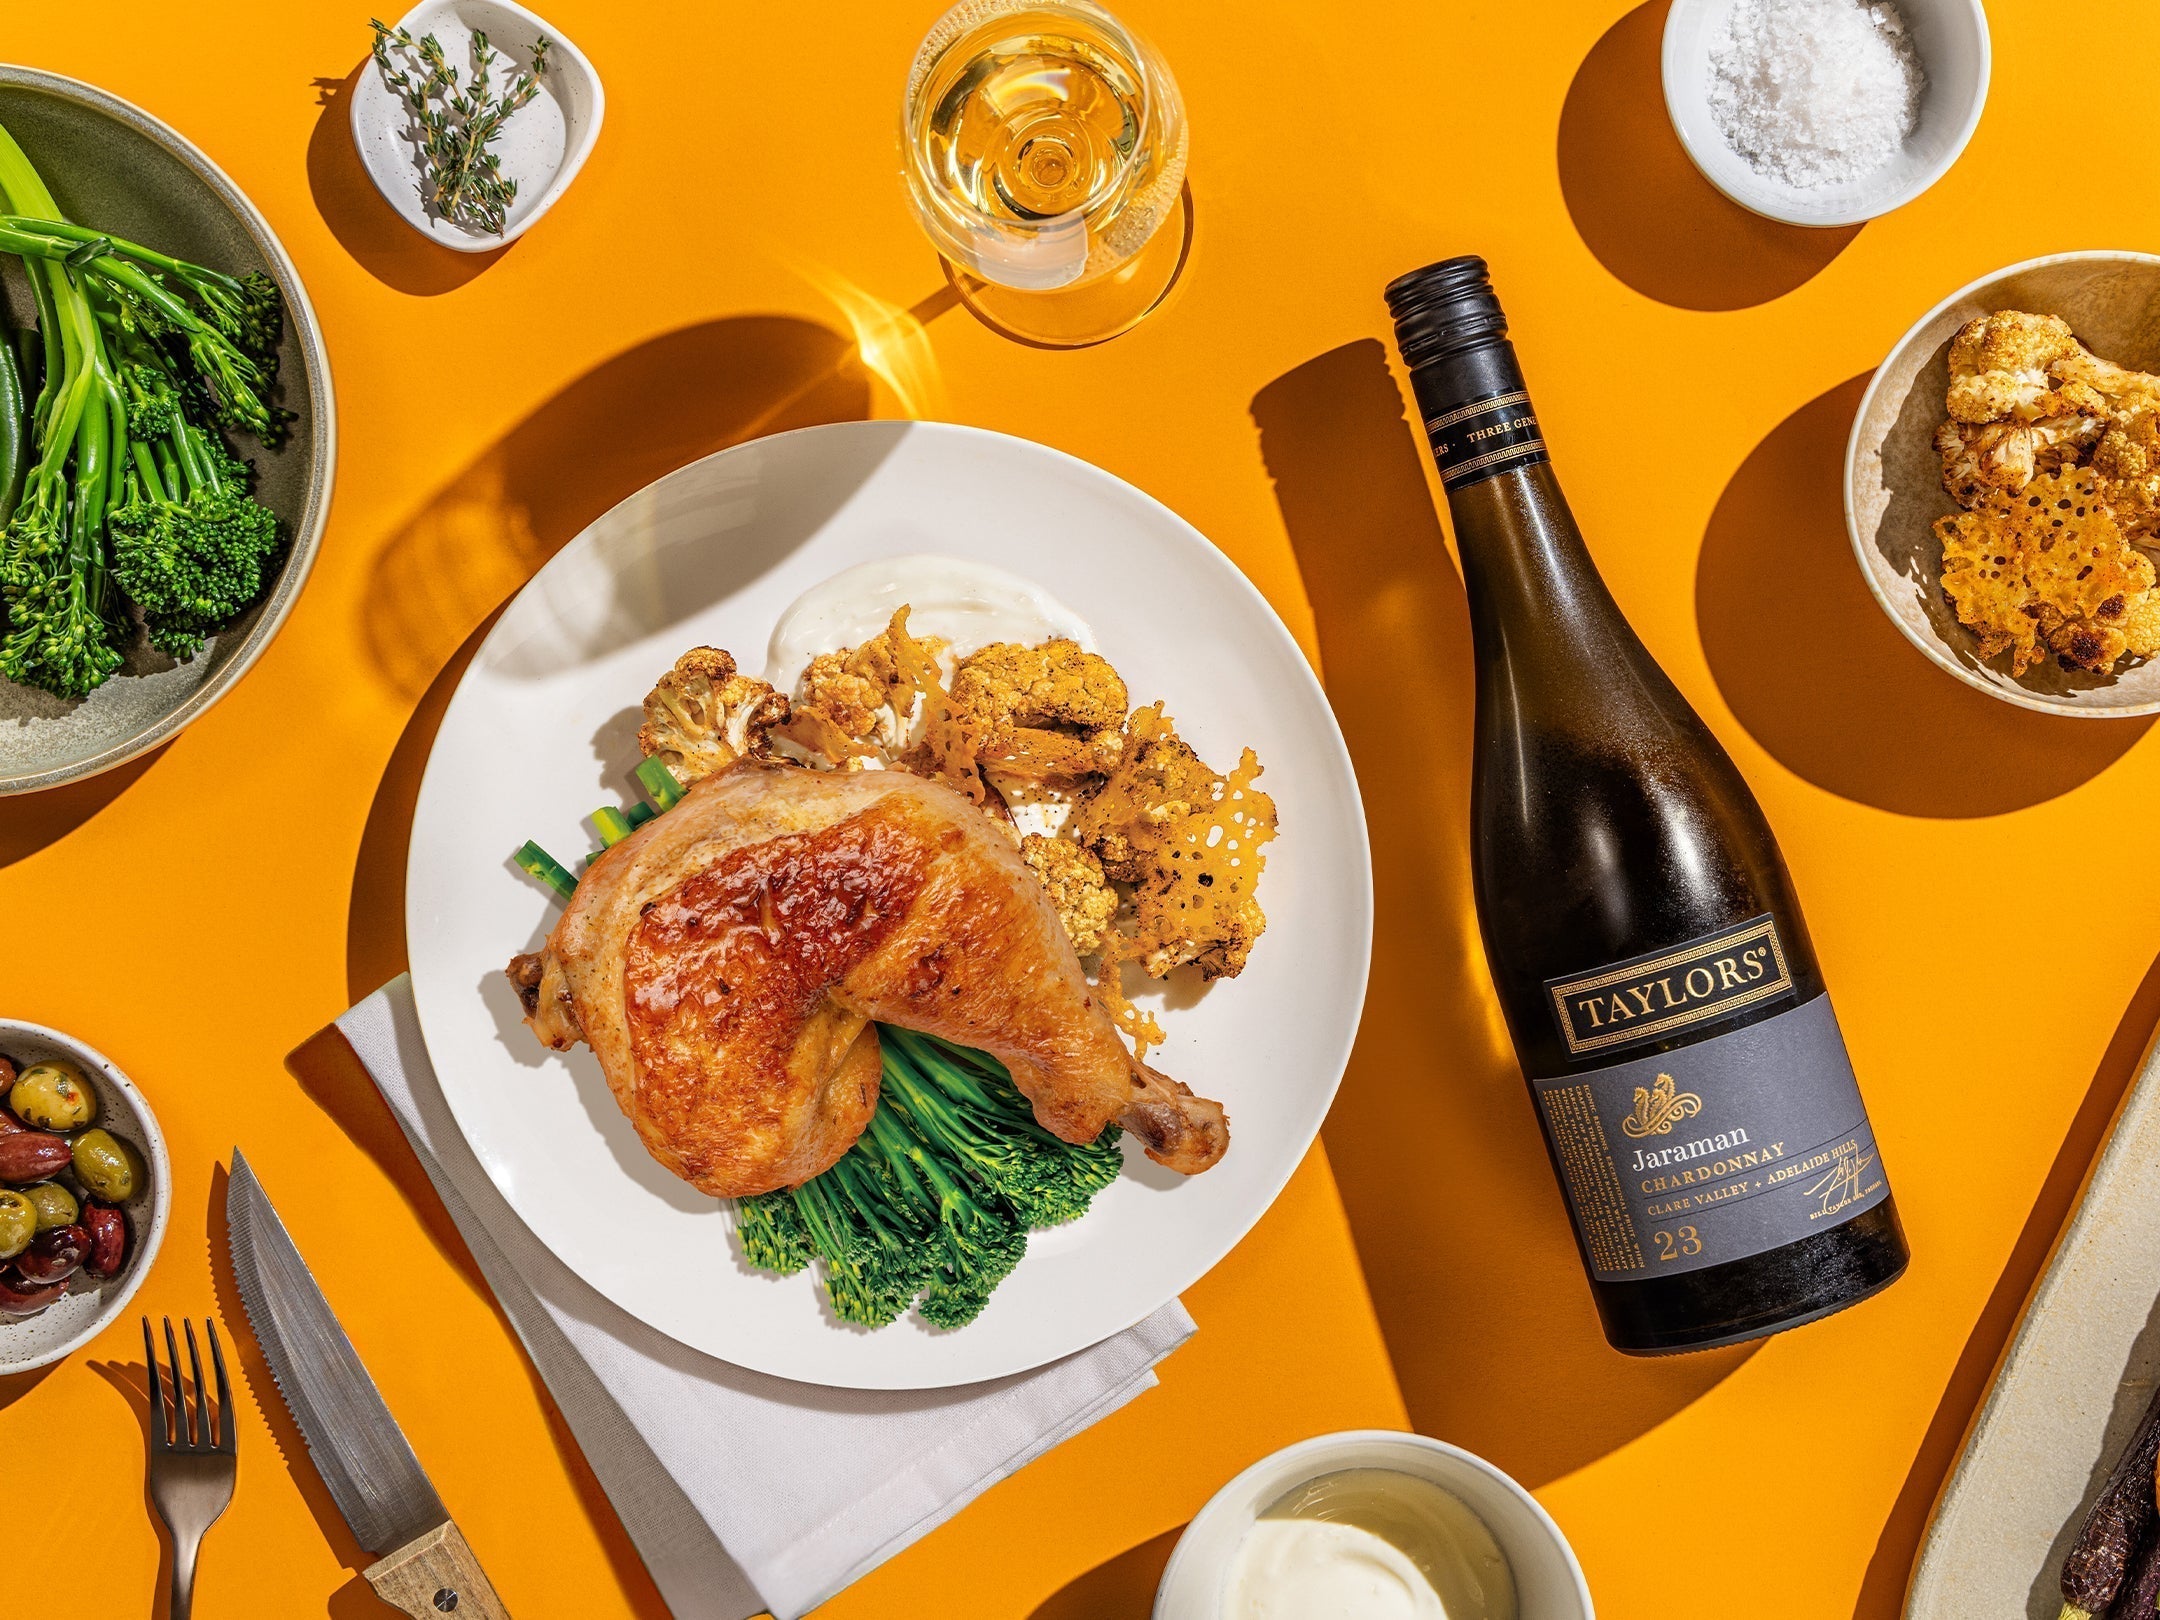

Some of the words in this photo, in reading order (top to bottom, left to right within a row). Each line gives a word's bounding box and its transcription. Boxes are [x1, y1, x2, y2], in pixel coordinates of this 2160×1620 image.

[1466, 421, 1511, 443] THREE
[1582, 1083, 1596, 1113] ICONIC
[1632, 1126, 1750, 1172] Jaraman
[1641, 1141, 1786, 1194] CHARDONNAY
[1647, 1198, 1691, 1217] CLARE
[1694, 1182, 1749, 1206] VALLEY
[1767, 1152, 1830, 1185] ADELAIDE
[1831, 1139, 1858, 1160] HILLS
[1653, 1225, 1702, 1262] 23
